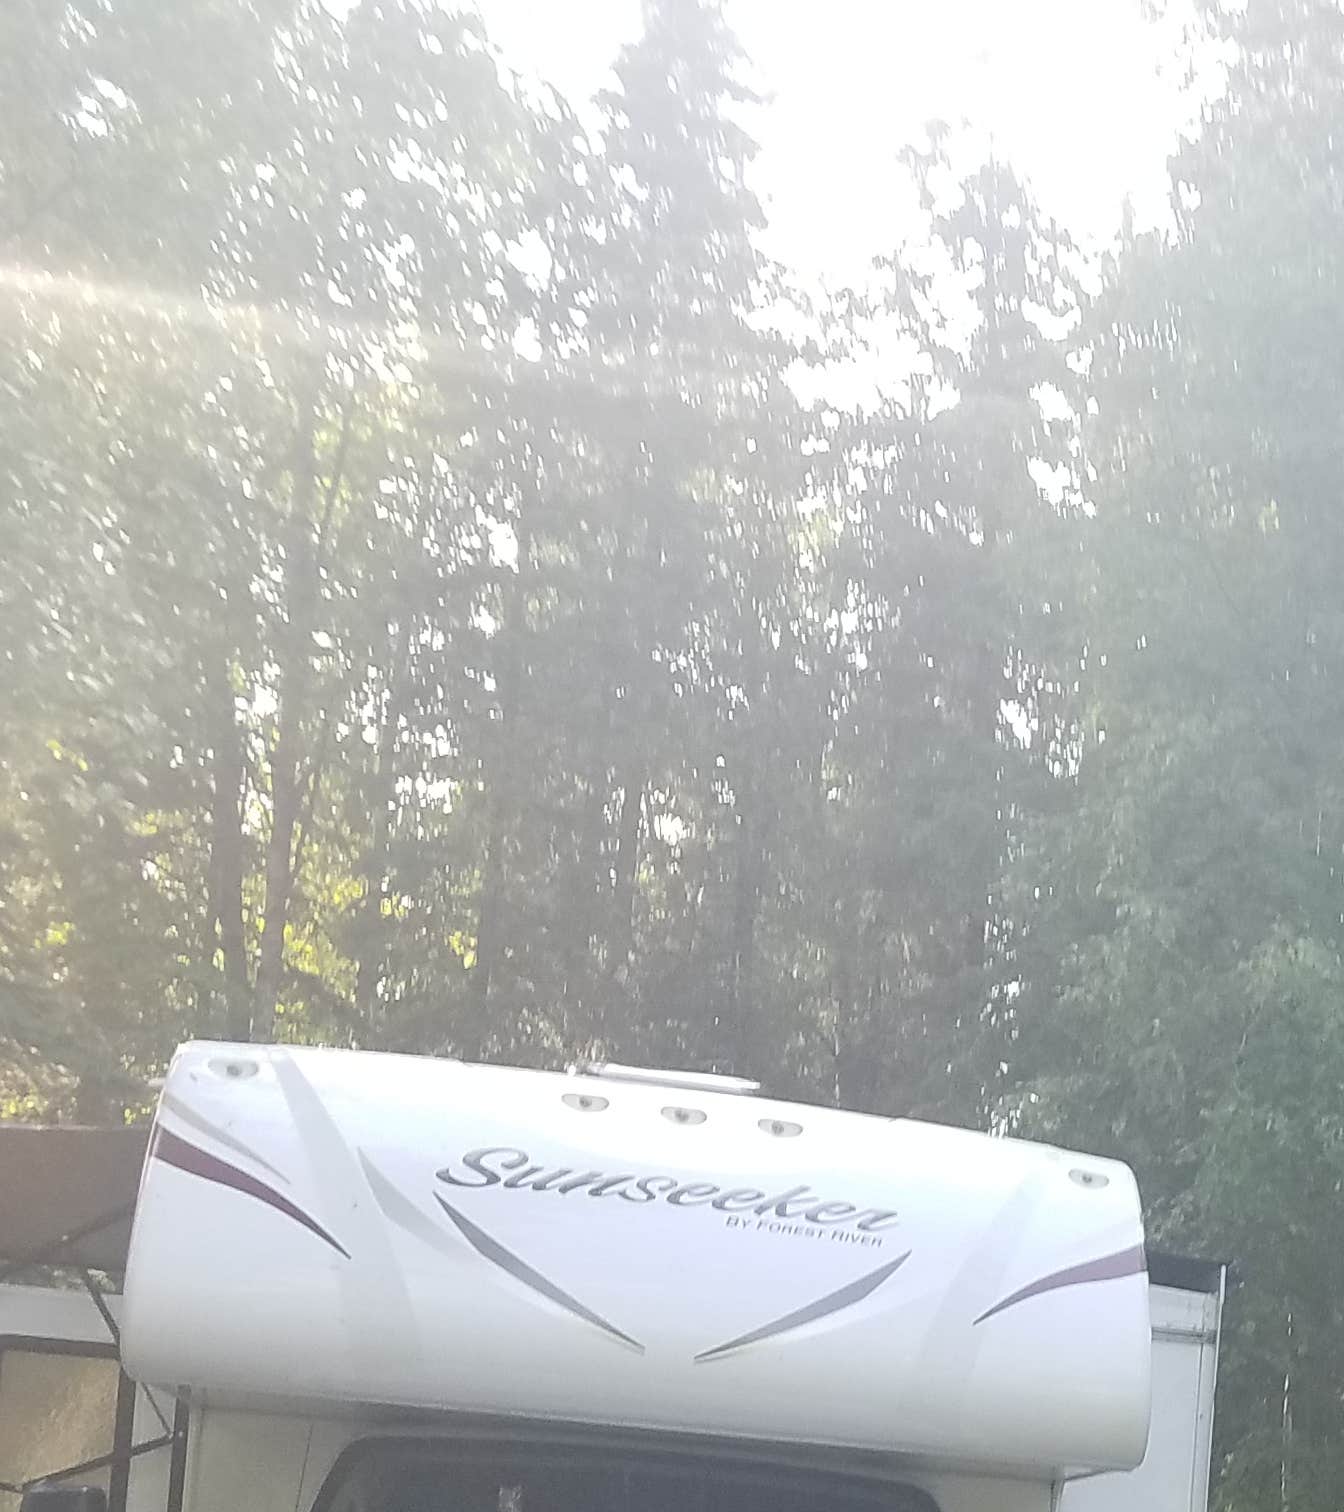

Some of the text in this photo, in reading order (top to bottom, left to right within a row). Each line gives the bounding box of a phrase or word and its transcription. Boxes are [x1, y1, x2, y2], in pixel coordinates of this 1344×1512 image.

[435, 1146, 898, 1231] Sunseeker
[756, 1219, 825, 1240] FOREST
[830, 1229, 883, 1247] RIVER
